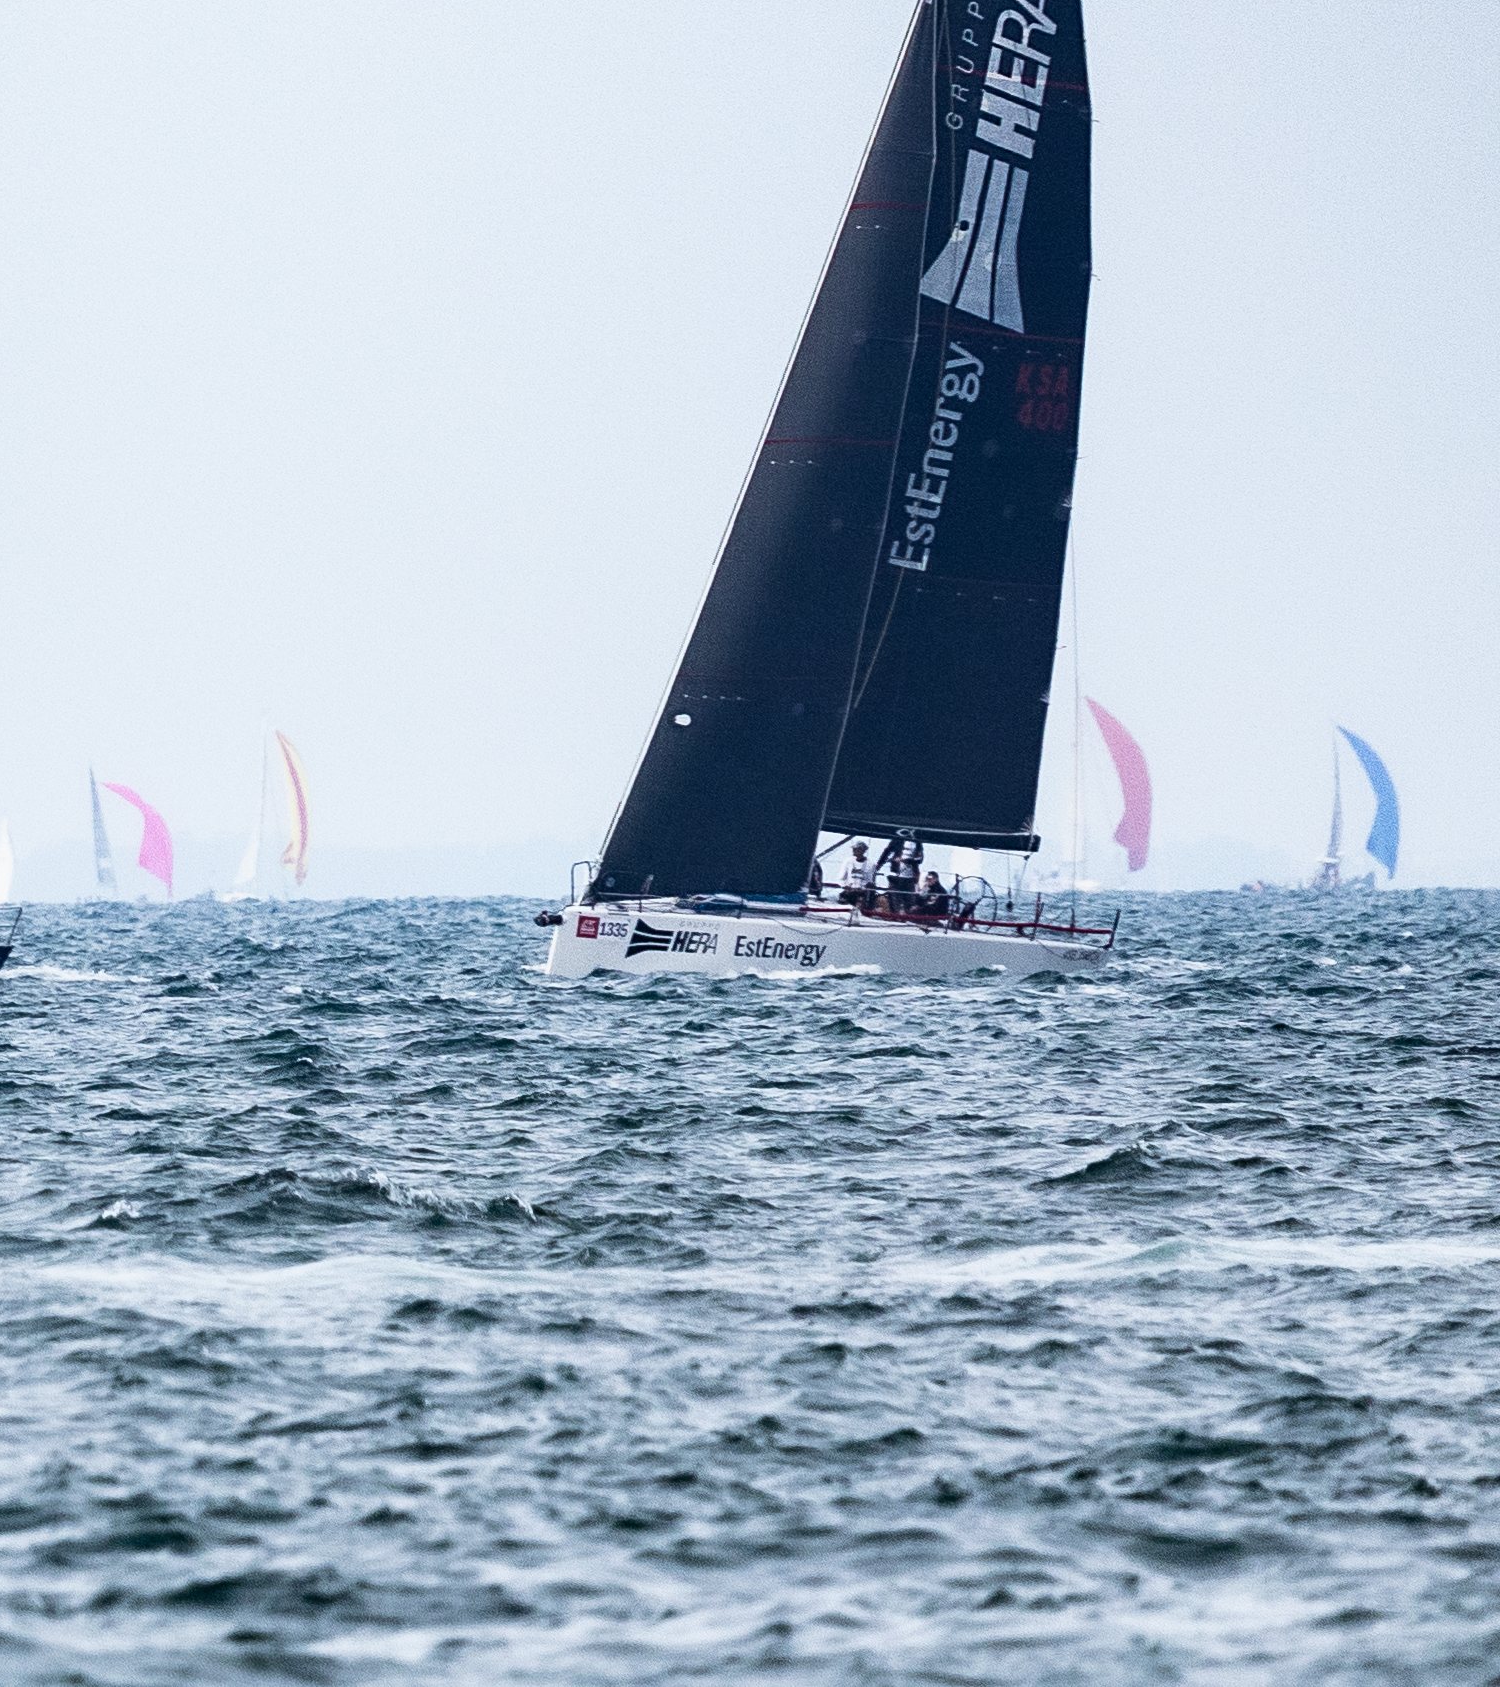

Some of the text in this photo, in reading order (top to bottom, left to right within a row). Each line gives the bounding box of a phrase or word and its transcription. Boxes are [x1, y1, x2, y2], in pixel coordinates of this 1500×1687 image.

[888, 341, 984, 572] EstEnergy
[599, 921, 629, 938] 1335
[671, 930, 718, 955] HERA
[734, 935, 827, 967] EstEnergy
